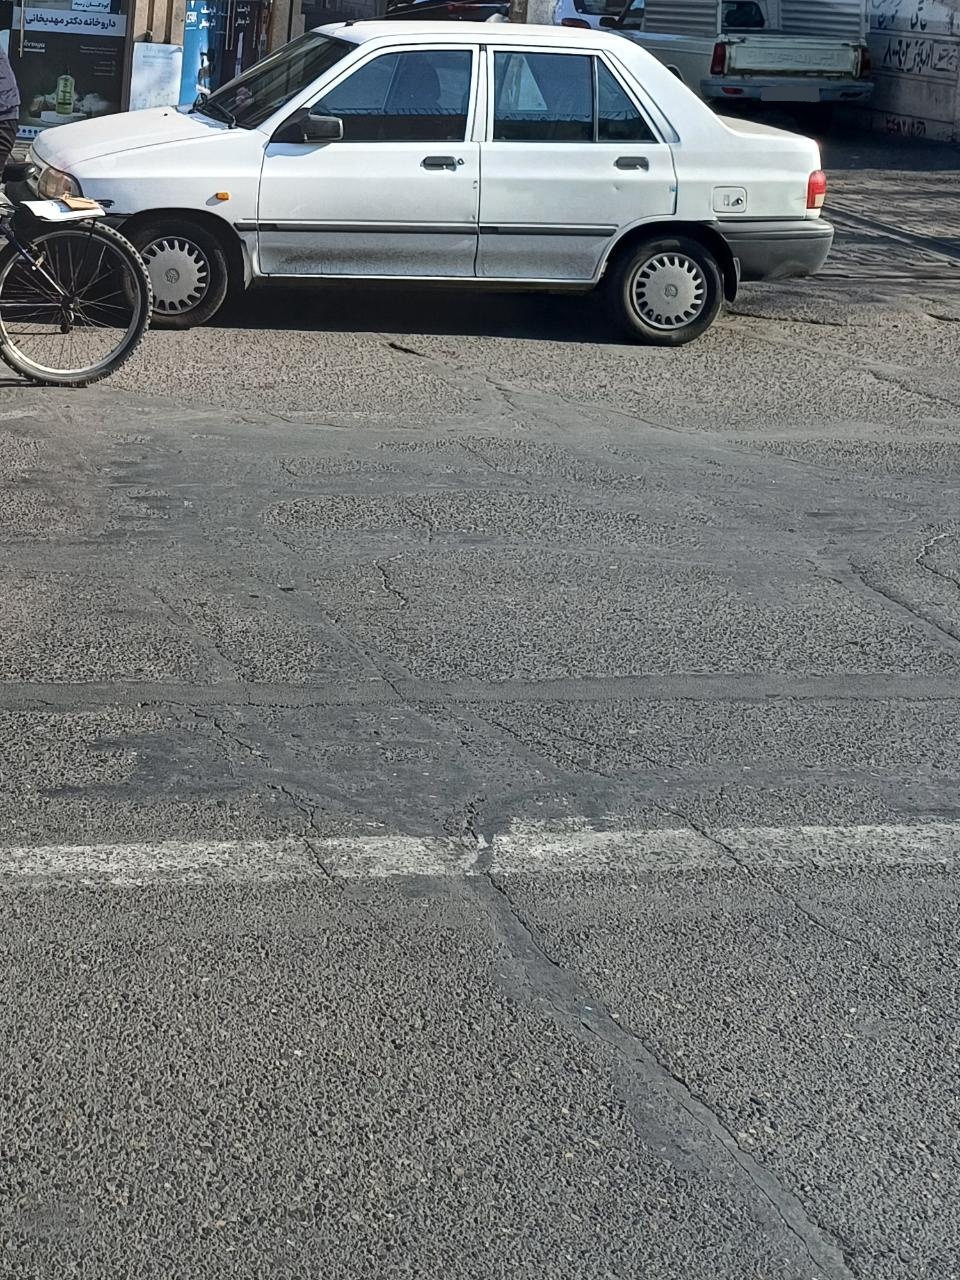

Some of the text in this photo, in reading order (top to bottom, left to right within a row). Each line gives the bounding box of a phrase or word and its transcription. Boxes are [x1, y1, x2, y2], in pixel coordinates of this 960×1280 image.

[25, 13, 116, 30] داروخانه دکتر مهدیخانی
